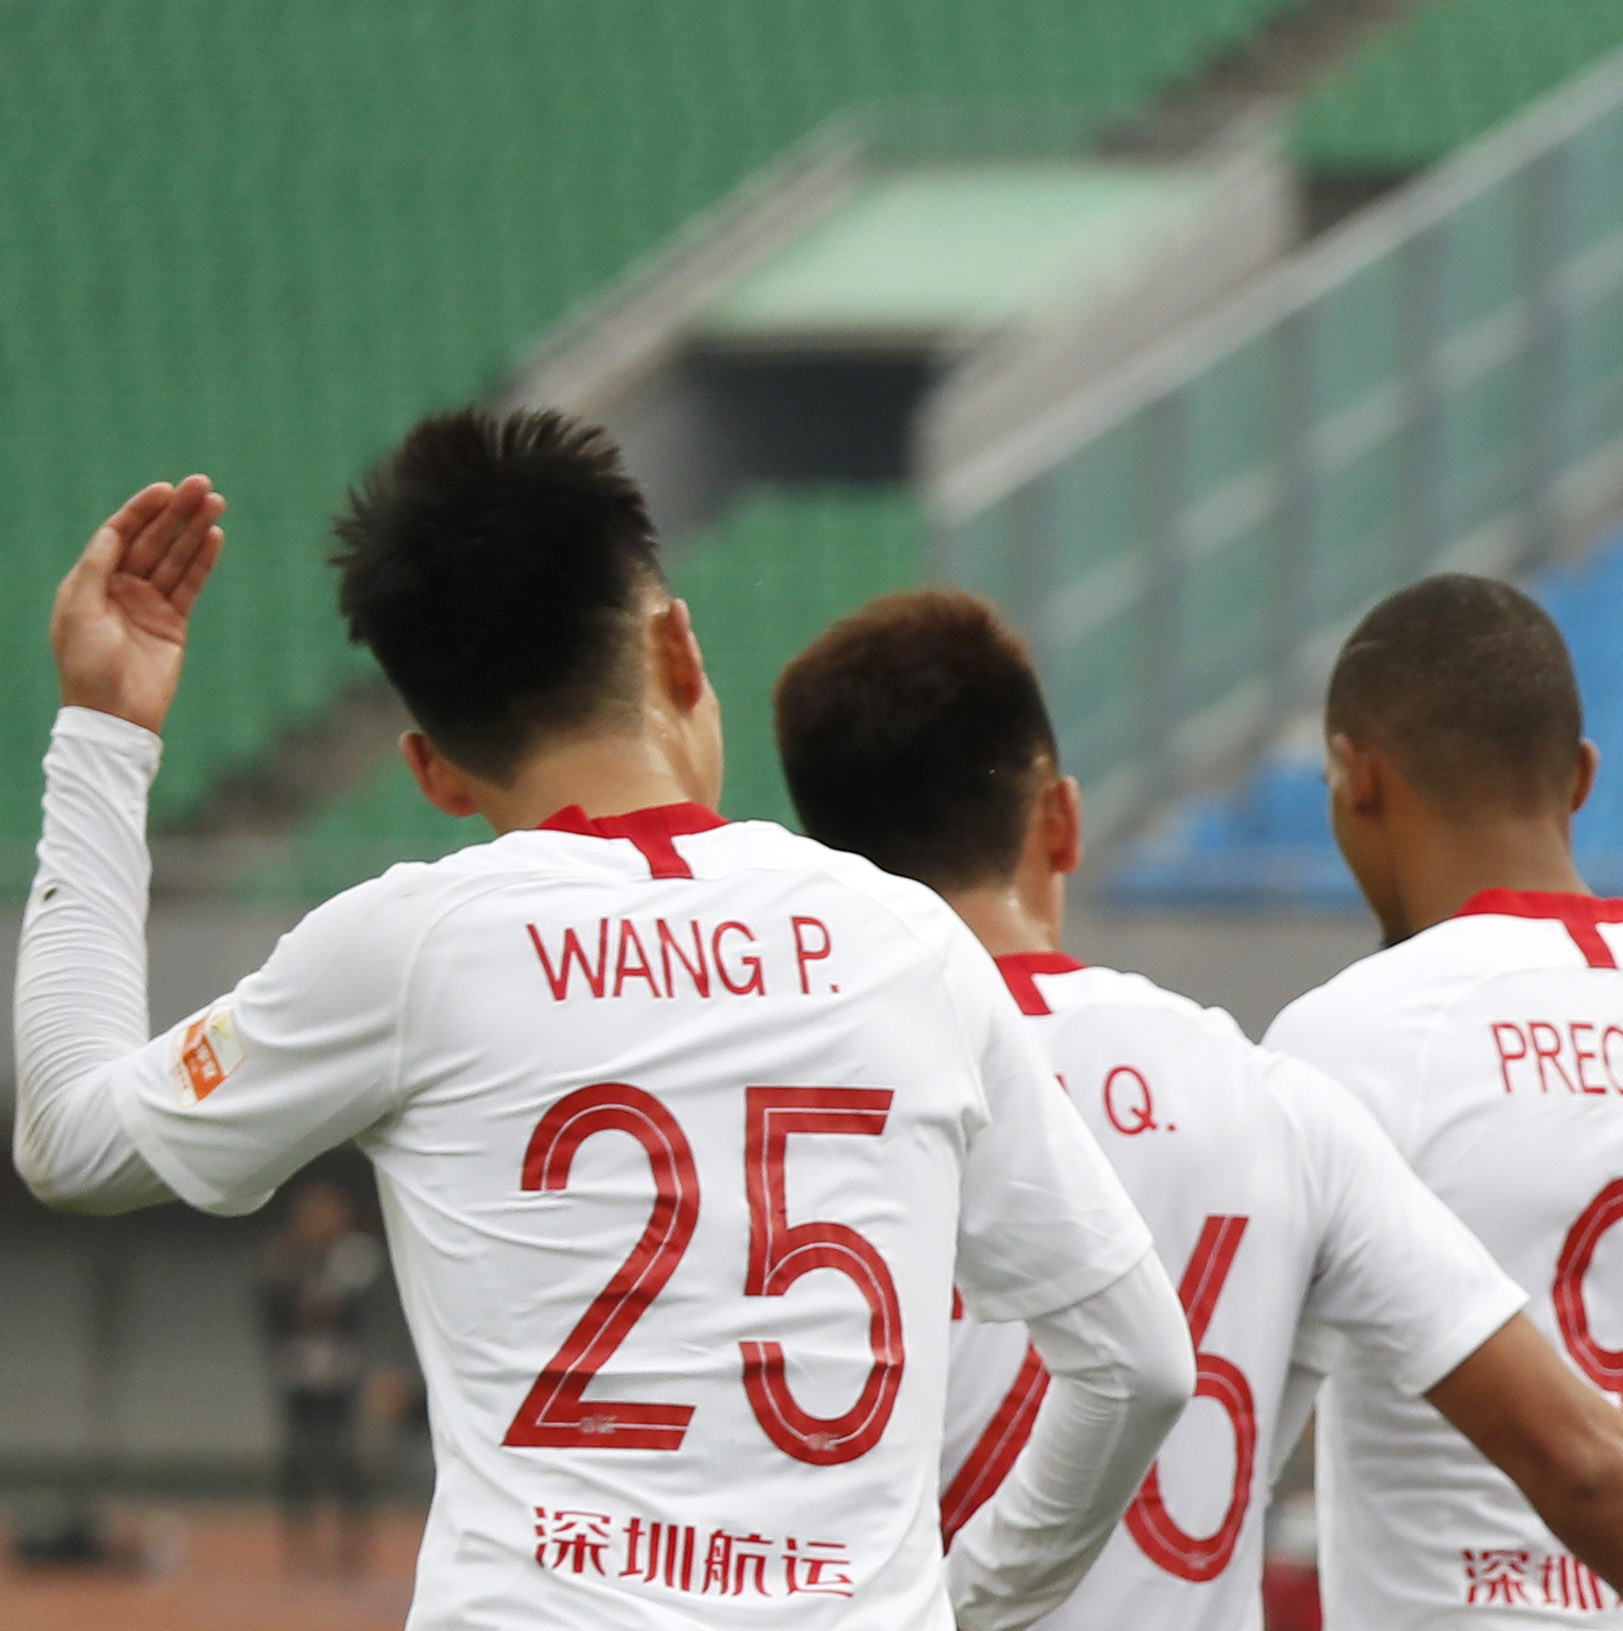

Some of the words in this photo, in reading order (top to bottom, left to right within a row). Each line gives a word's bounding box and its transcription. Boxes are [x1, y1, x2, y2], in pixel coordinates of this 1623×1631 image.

[527, 917, 766, 1001] WANG
[791, 915, 840, 996] P.
[1103, 1065, 1177, 1136] Q.
[501, 1082, 905, 1467] 25
[533, 1506, 855, 1598] 深圳航运
